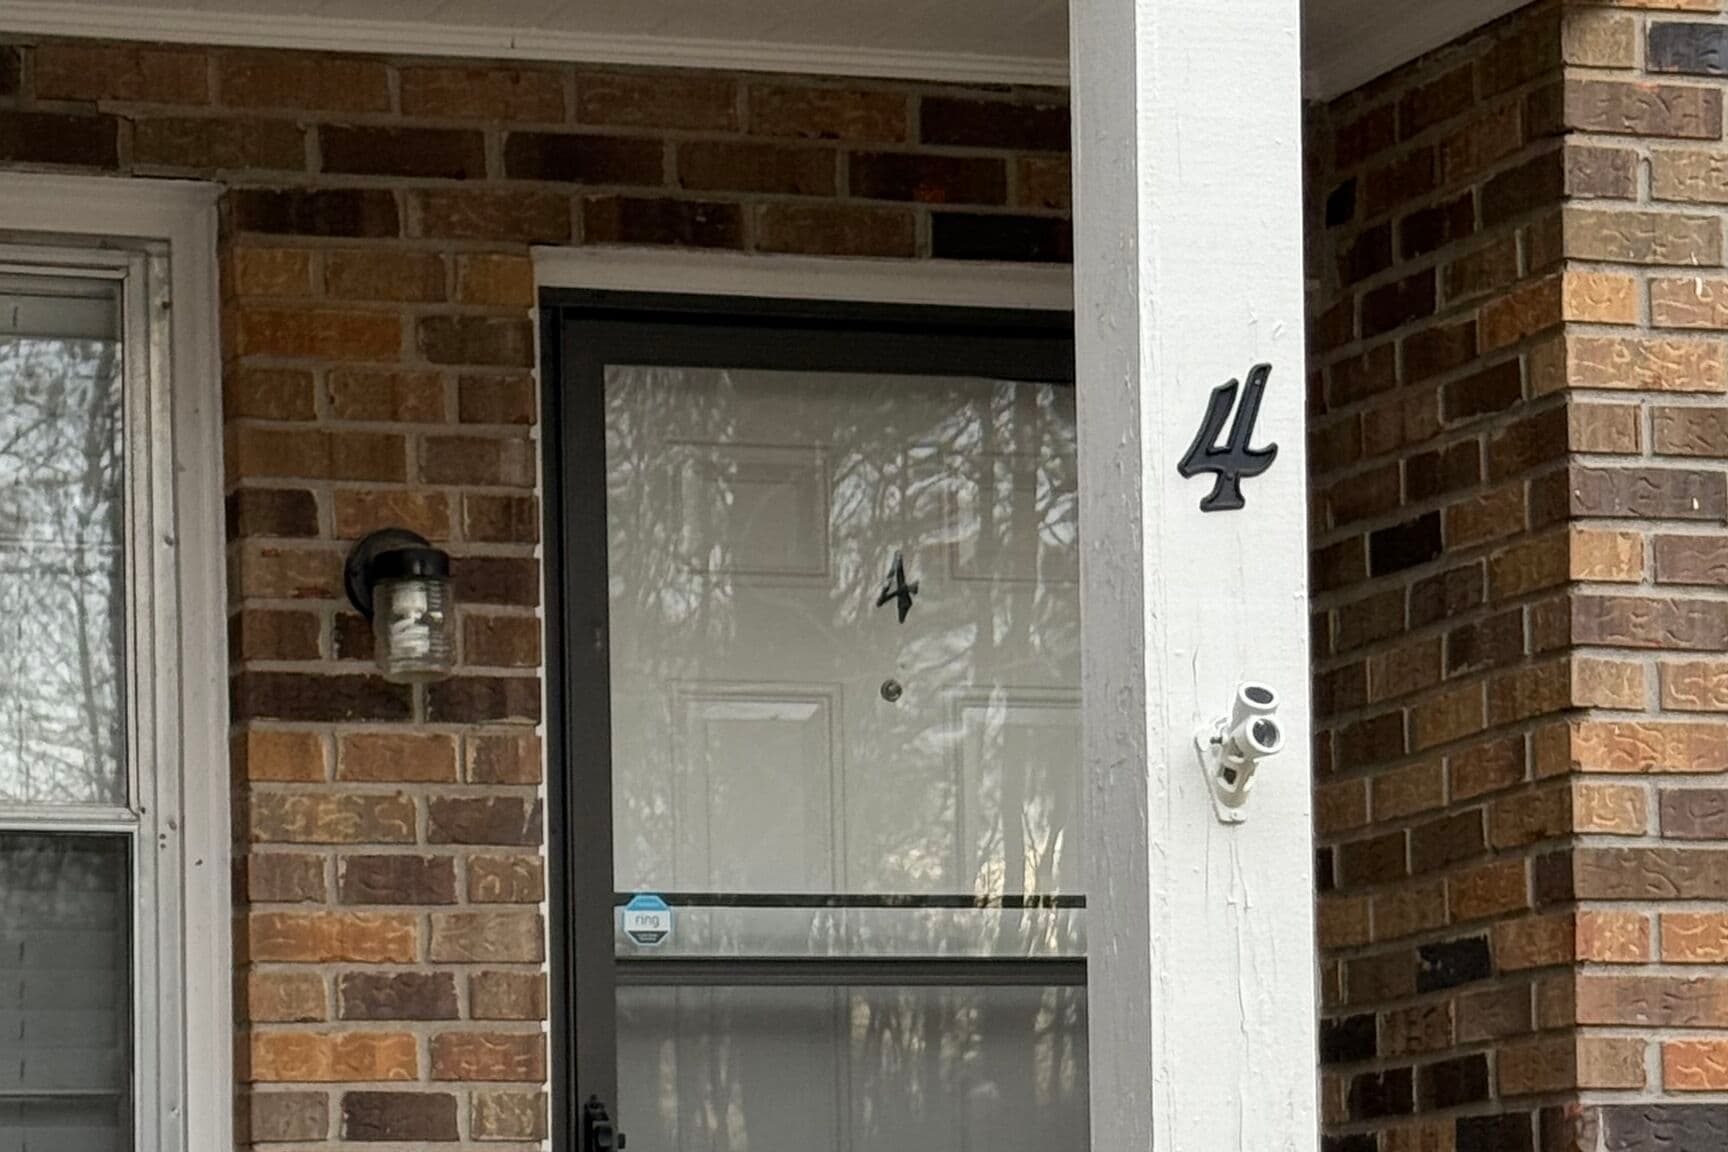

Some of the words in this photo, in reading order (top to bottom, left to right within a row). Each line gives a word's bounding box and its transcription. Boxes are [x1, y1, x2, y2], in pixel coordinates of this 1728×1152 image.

[1177, 362, 1278, 513] 4
[876, 550, 919, 624] 4
[635, 914, 660, 928] ring
